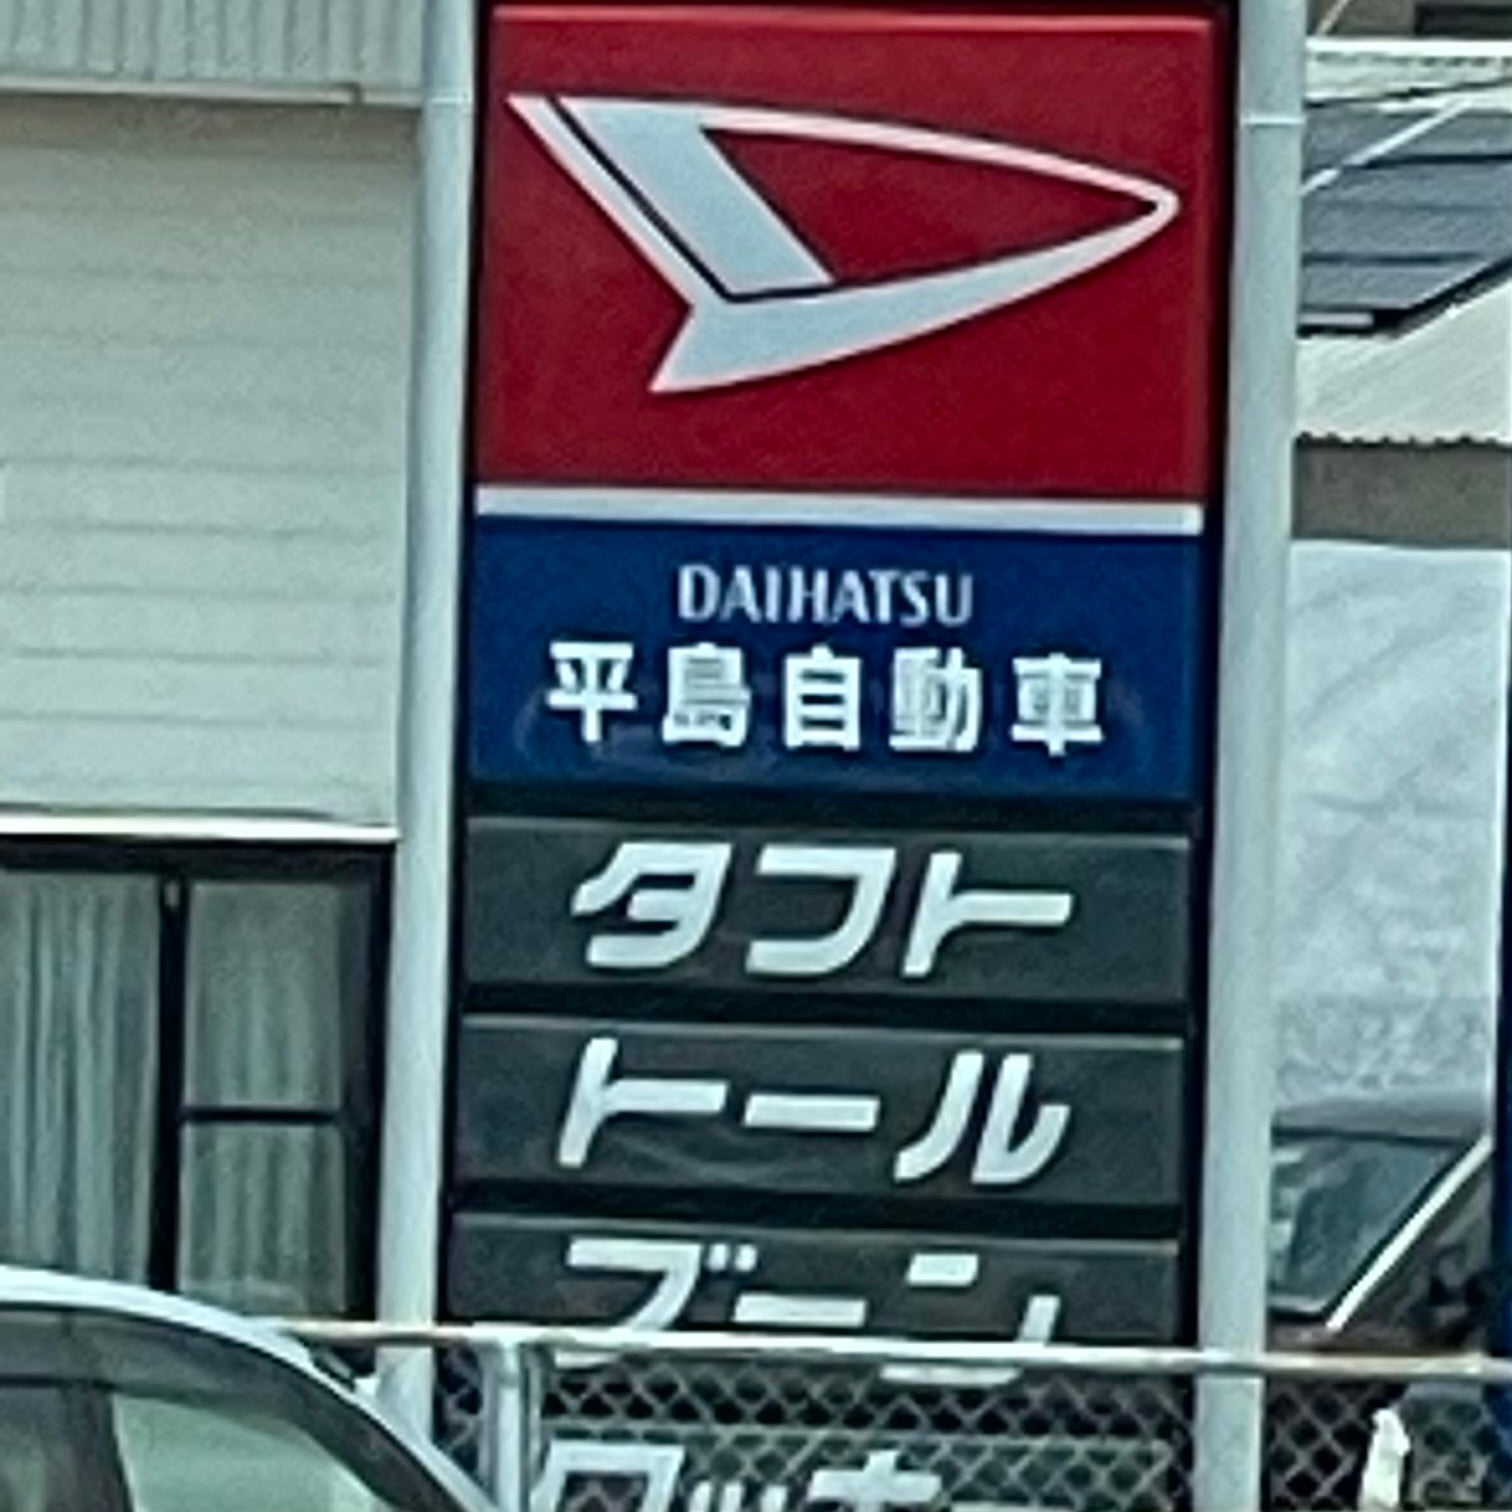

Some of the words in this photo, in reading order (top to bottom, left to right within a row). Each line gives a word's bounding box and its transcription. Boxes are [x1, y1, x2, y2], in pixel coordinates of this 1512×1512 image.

[676, 563, 975, 626] DAIHATSU
[545, 640, 1104, 758] 平島自動車
[571, 840, 1075, 979] タフト
[556, 1036, 1072, 1185] トール
[550, 1236, 1062, 1387] ブーン
